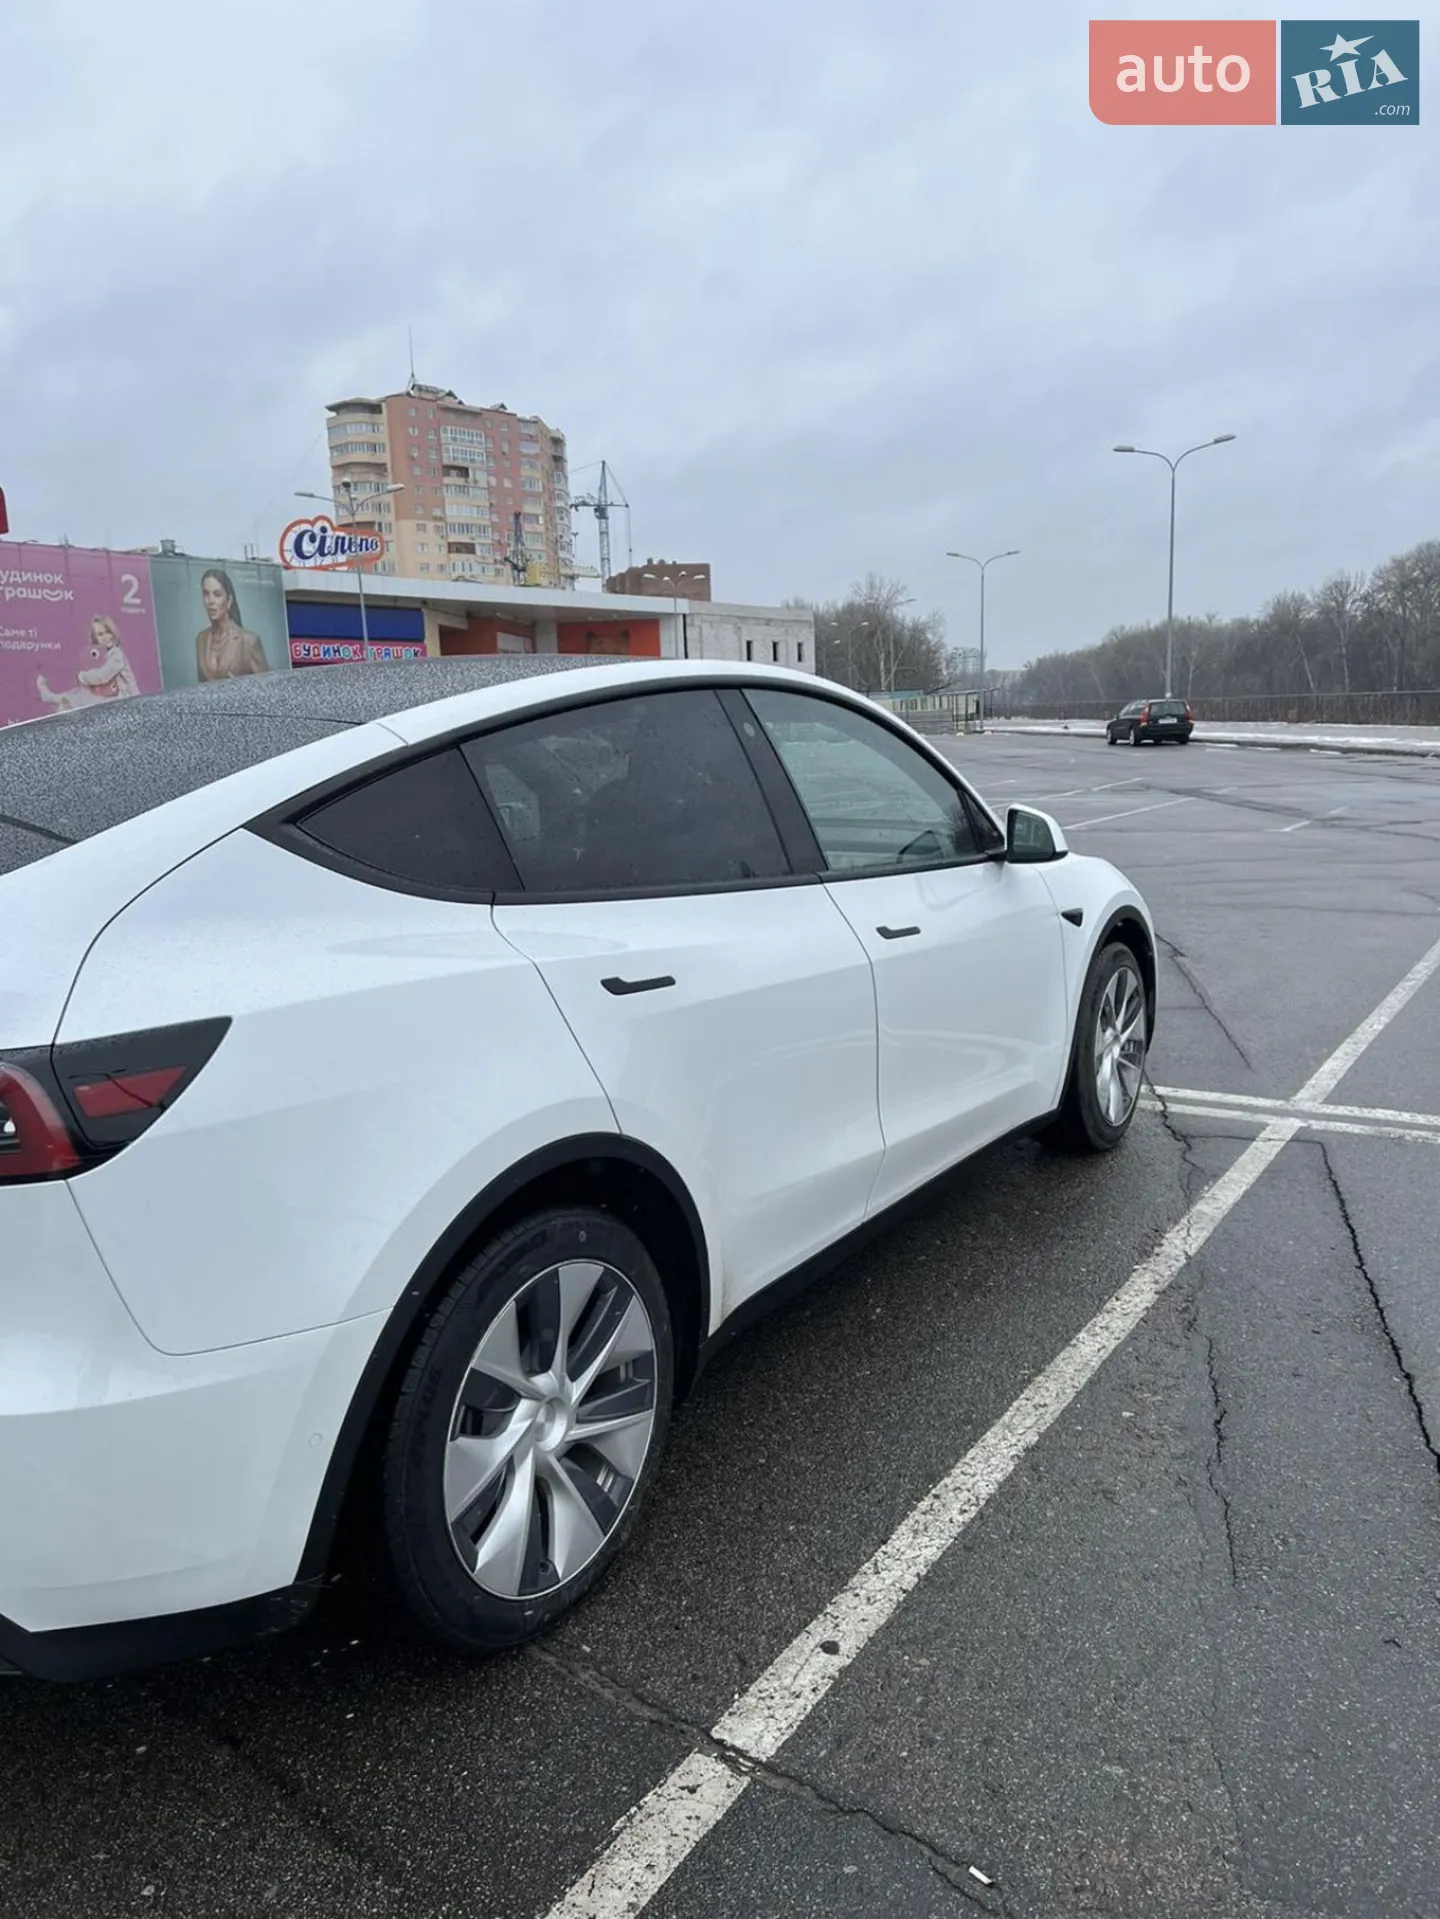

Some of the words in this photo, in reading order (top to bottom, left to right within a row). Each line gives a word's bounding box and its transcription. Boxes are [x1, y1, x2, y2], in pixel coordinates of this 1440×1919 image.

[293, 525, 379, 560] Сільпо
[121, 574, 142, 604] 2
[291, 642, 361, 660] БУДИНОК
[364, 645, 421, 660] ГРАШОК
